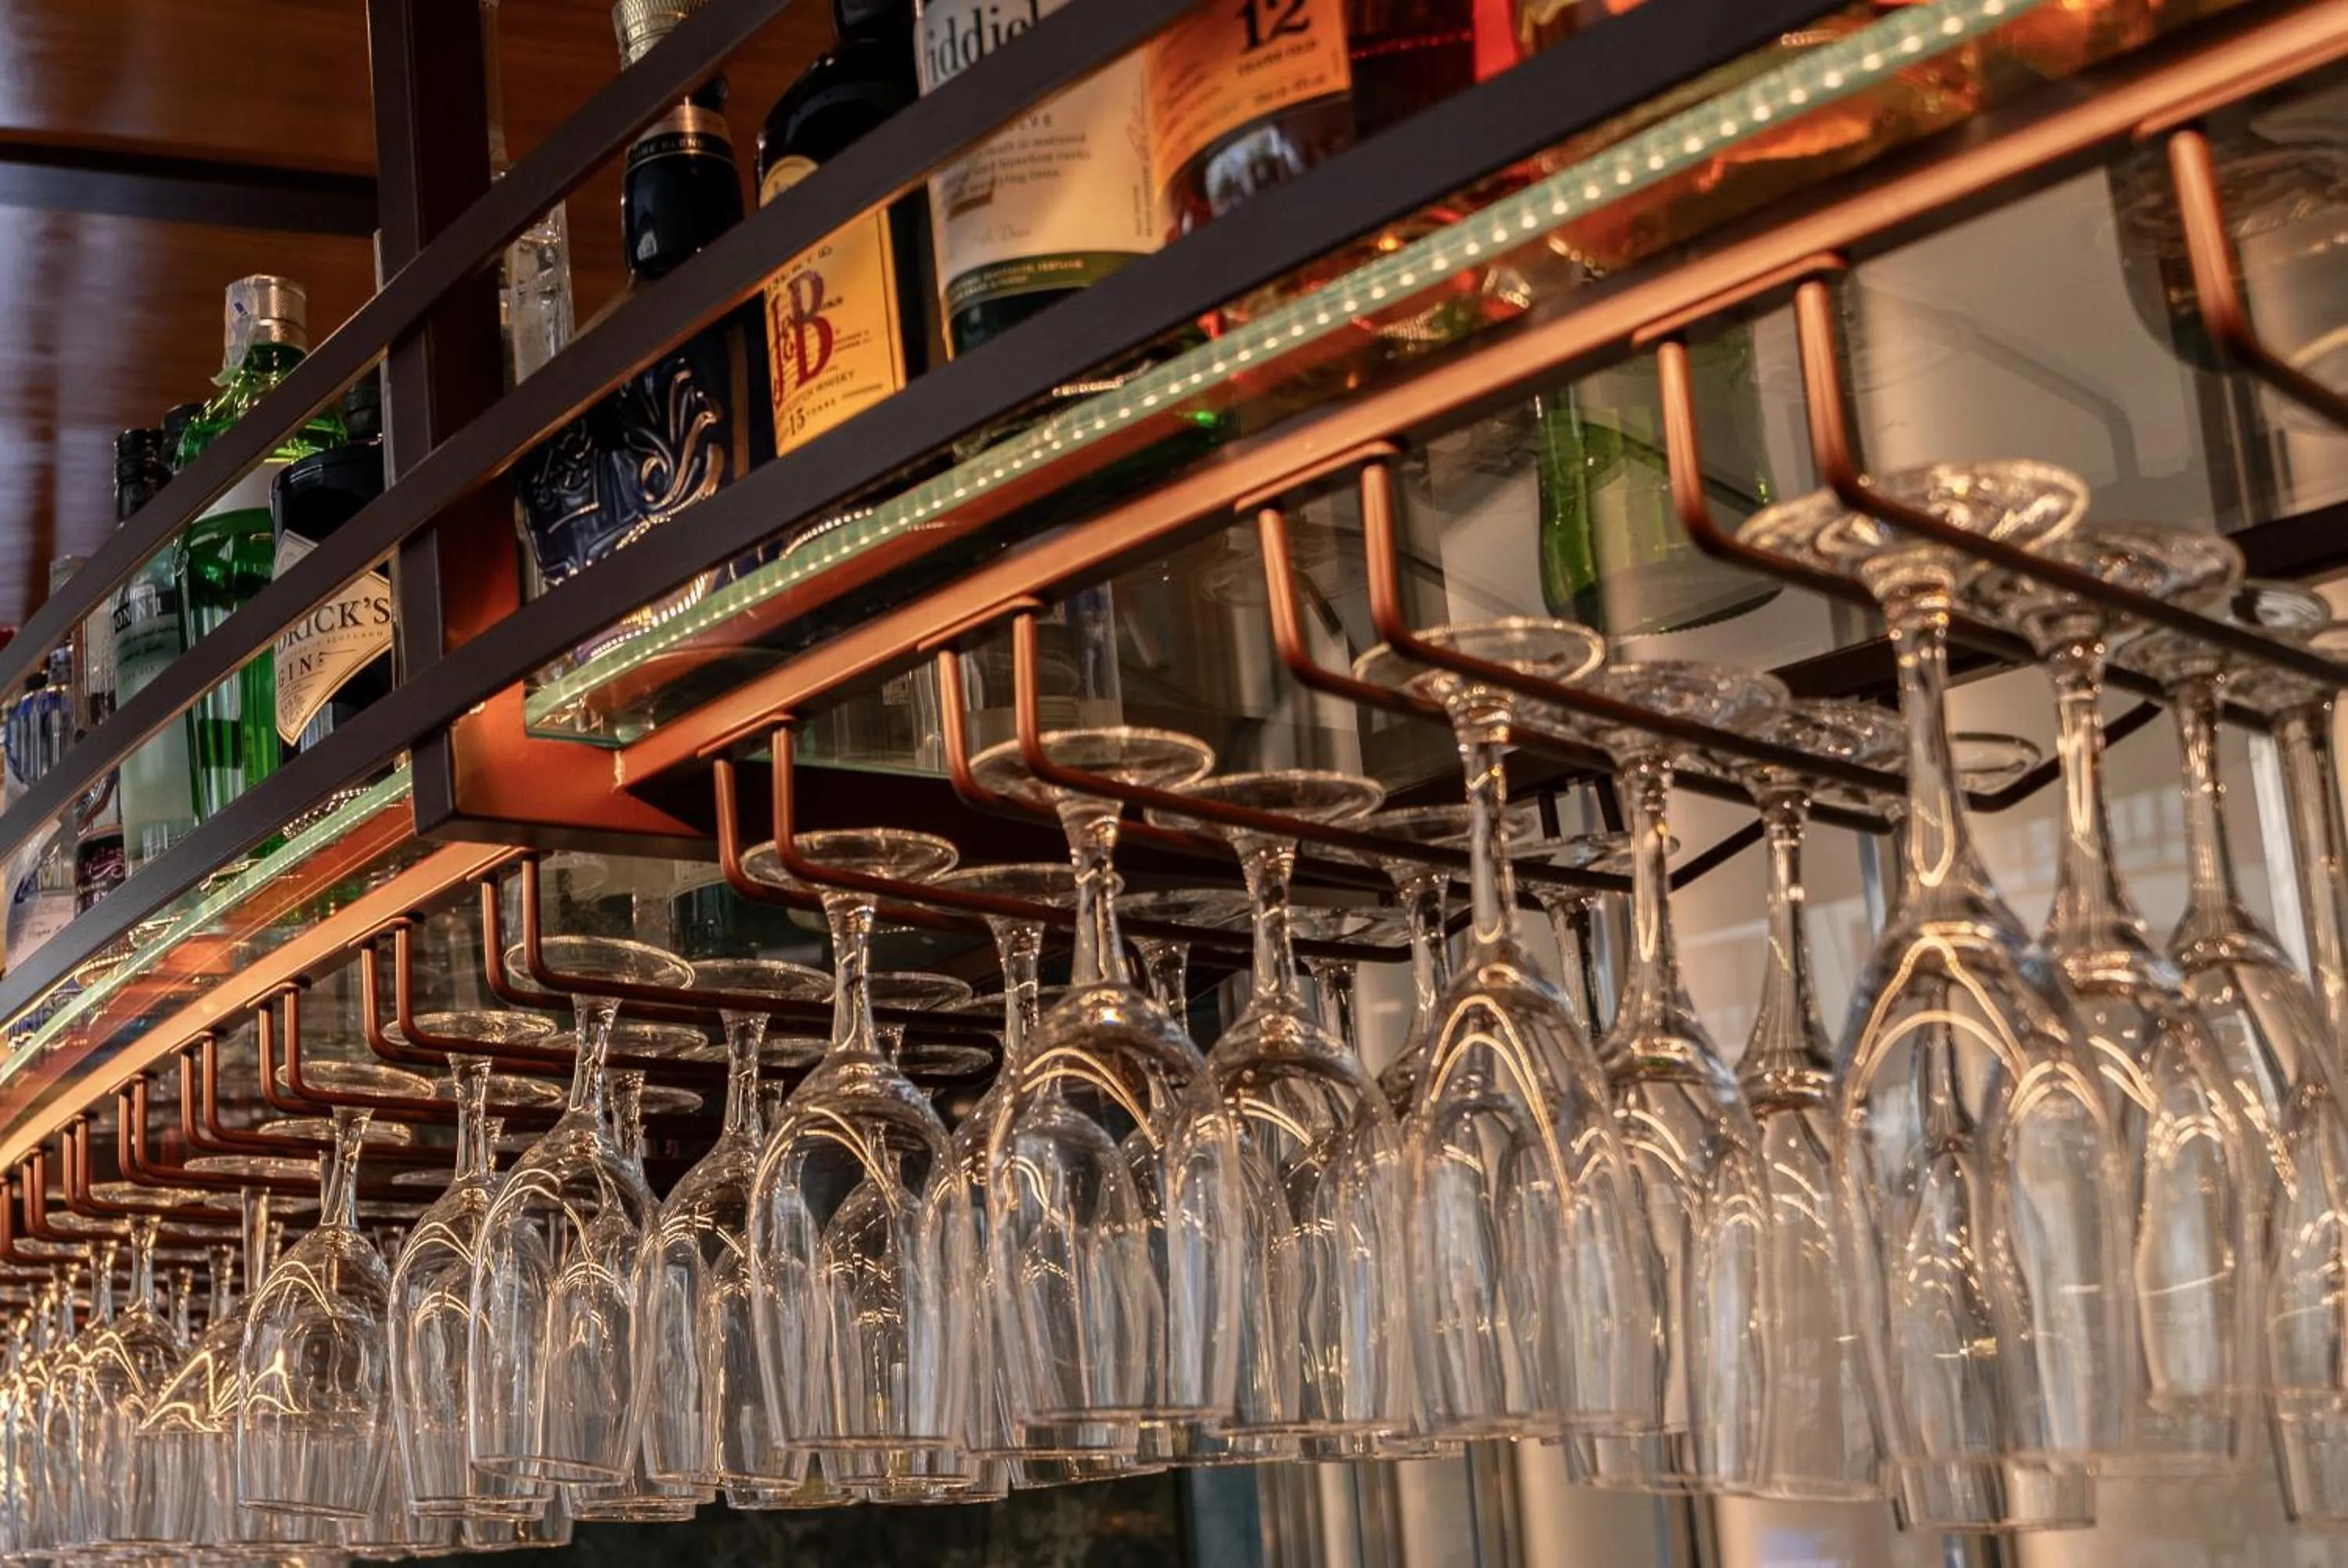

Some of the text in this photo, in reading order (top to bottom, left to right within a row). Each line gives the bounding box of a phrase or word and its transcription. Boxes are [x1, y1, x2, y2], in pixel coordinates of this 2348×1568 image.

[1234, 0, 1311, 55] 12
[789, 407, 805, 437] 15
[278, 653, 313, 689] GIN
